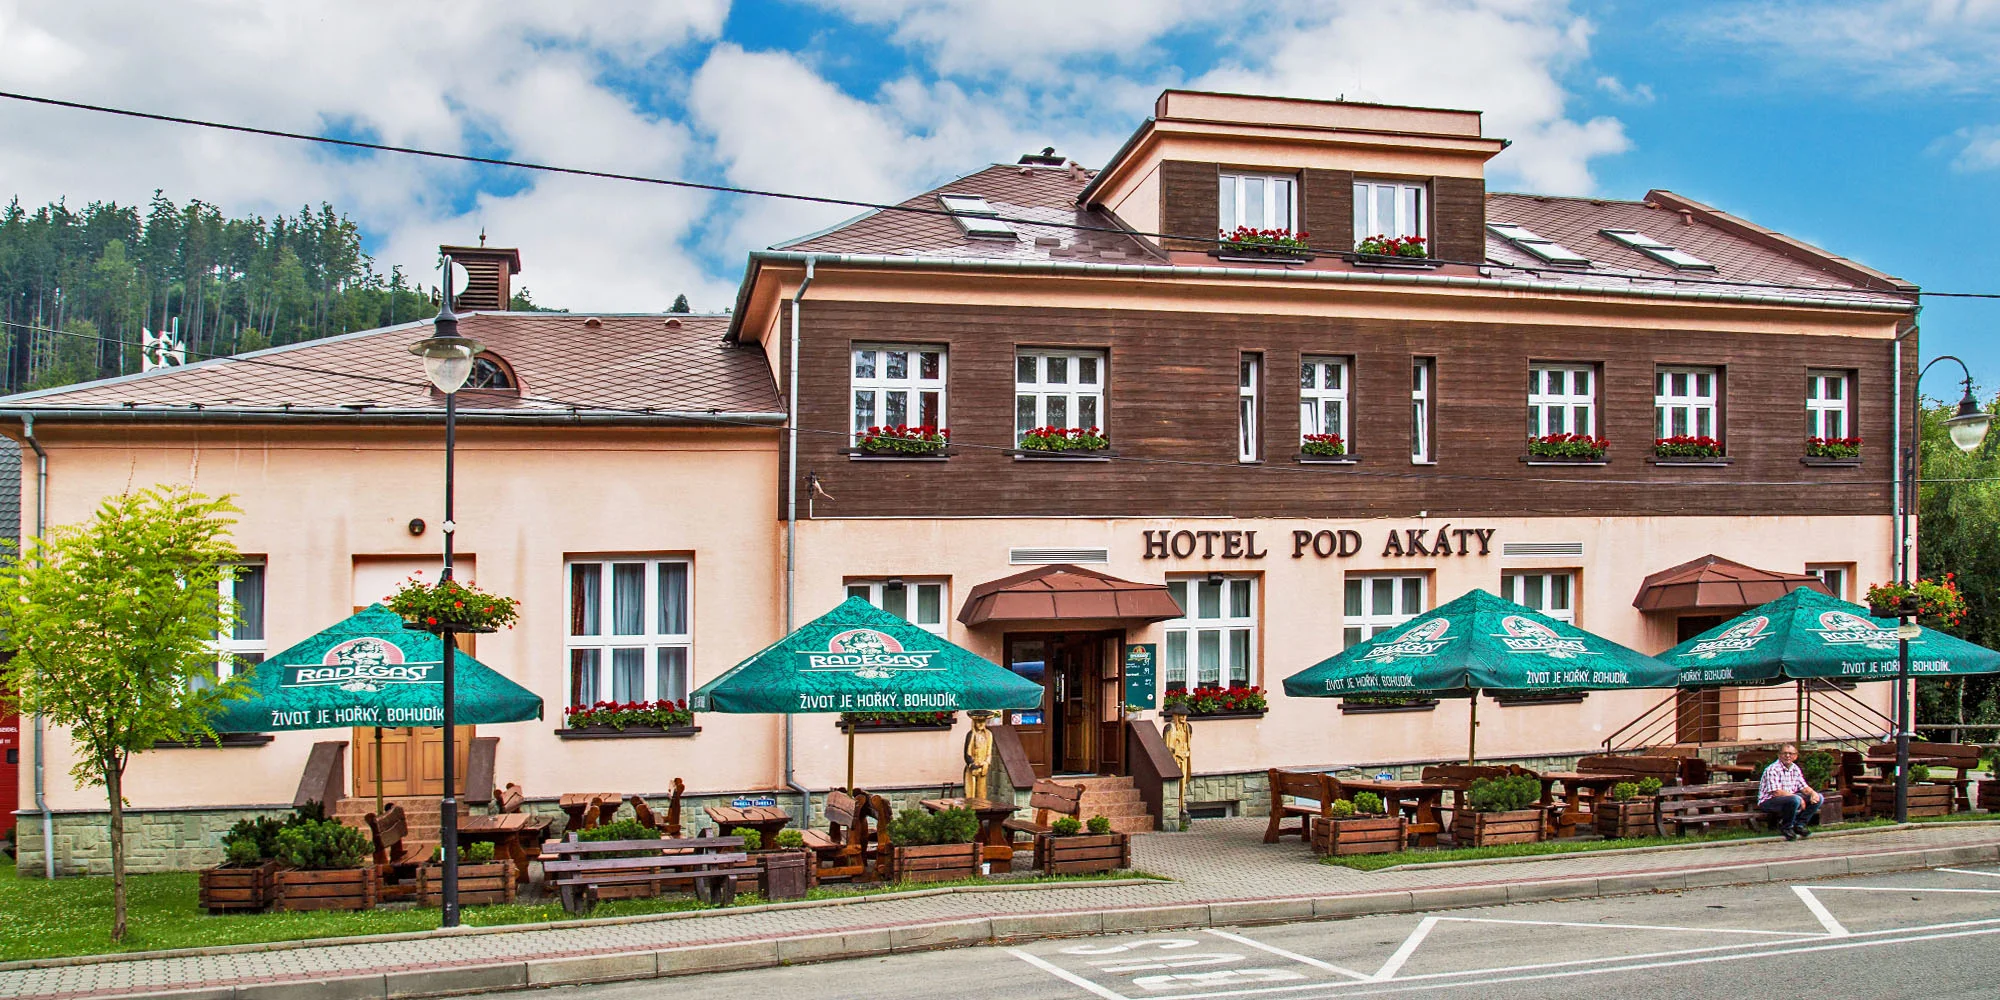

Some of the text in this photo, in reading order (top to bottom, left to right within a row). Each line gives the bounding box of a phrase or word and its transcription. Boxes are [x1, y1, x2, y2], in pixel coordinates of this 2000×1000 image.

[1142, 523, 1496, 559] HOTEL POD AKÁTY
[1364, 640, 1449, 658] RADEGAST
[1502, 638, 1588, 652] RADEGAST
[809, 654, 933, 668] RADEGAST
[1842, 661, 1865, 674] ŽIVOT
[1869, 661, 1878, 673] JE
[1912, 659, 1951, 672] BOHUDÍK.
[296, 664, 434, 683] RADEGAST
[1526, 669, 1629, 684] ŽIVOT JE HOŘKÝ. BOHUDÍK.
[1347, 677, 1355, 689] JE
[800, 691, 960, 709] ŽIVOT JE HOŘKÝ. BOHUDÍK.
[272, 710, 311, 726] ŽIVOT
[316, 709, 330, 724] JE
[335, 706, 382, 722] HOŘKÝ.
[1060, 938, 1309, 990] BUS
